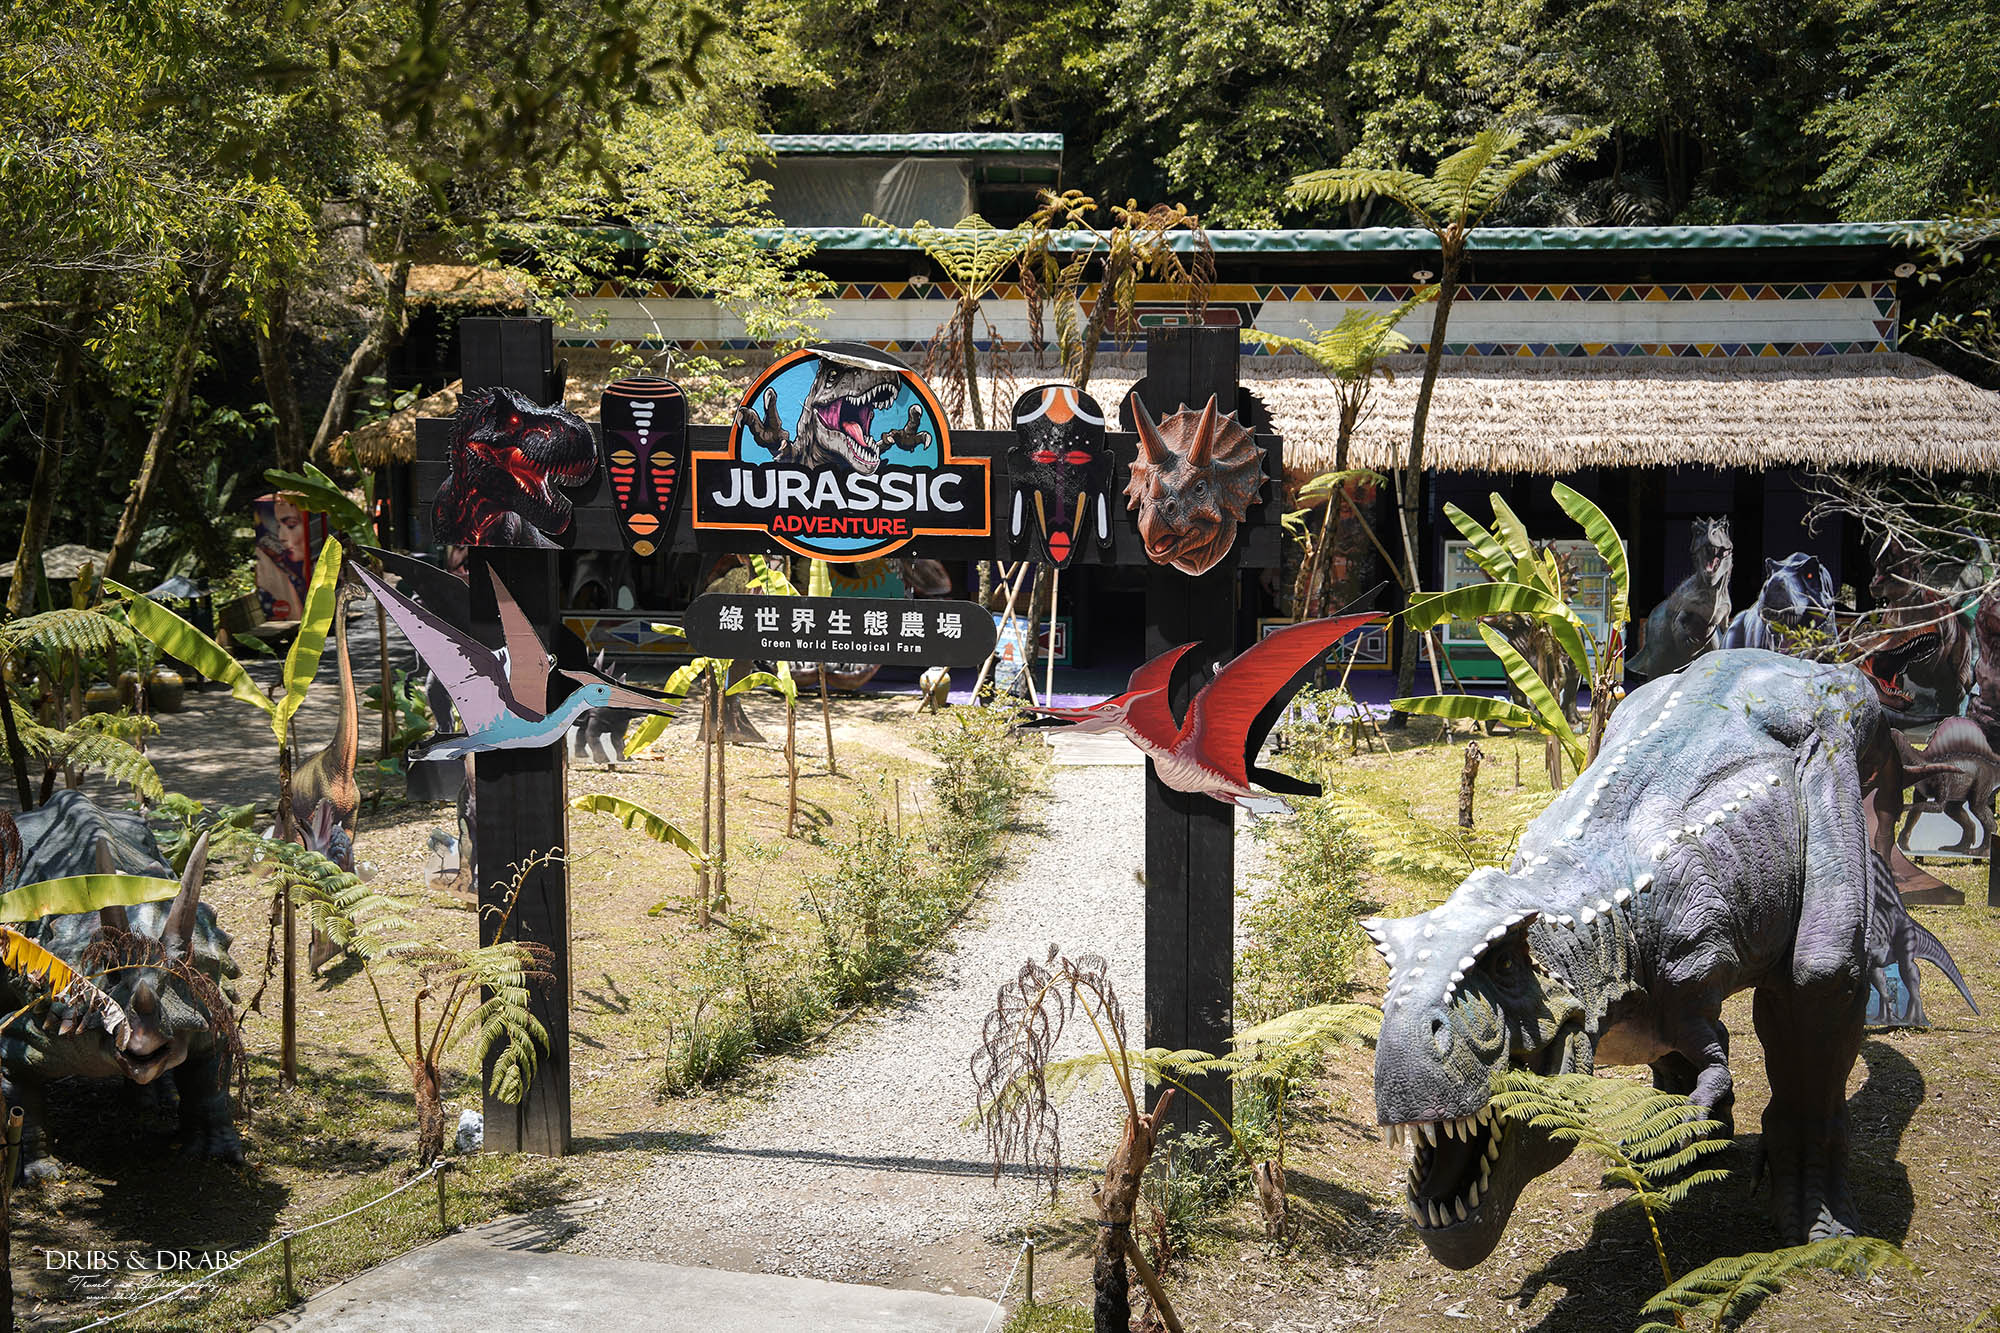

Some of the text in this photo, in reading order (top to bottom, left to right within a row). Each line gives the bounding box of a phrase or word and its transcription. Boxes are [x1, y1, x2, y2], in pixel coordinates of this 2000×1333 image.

[712, 468, 964, 512] JURASSIC
[772, 515, 908, 536] ADVENTURE
[719, 606, 962, 639] 綠世界生態農場
[761, 638, 922, 653] Green World Ecological Farm
